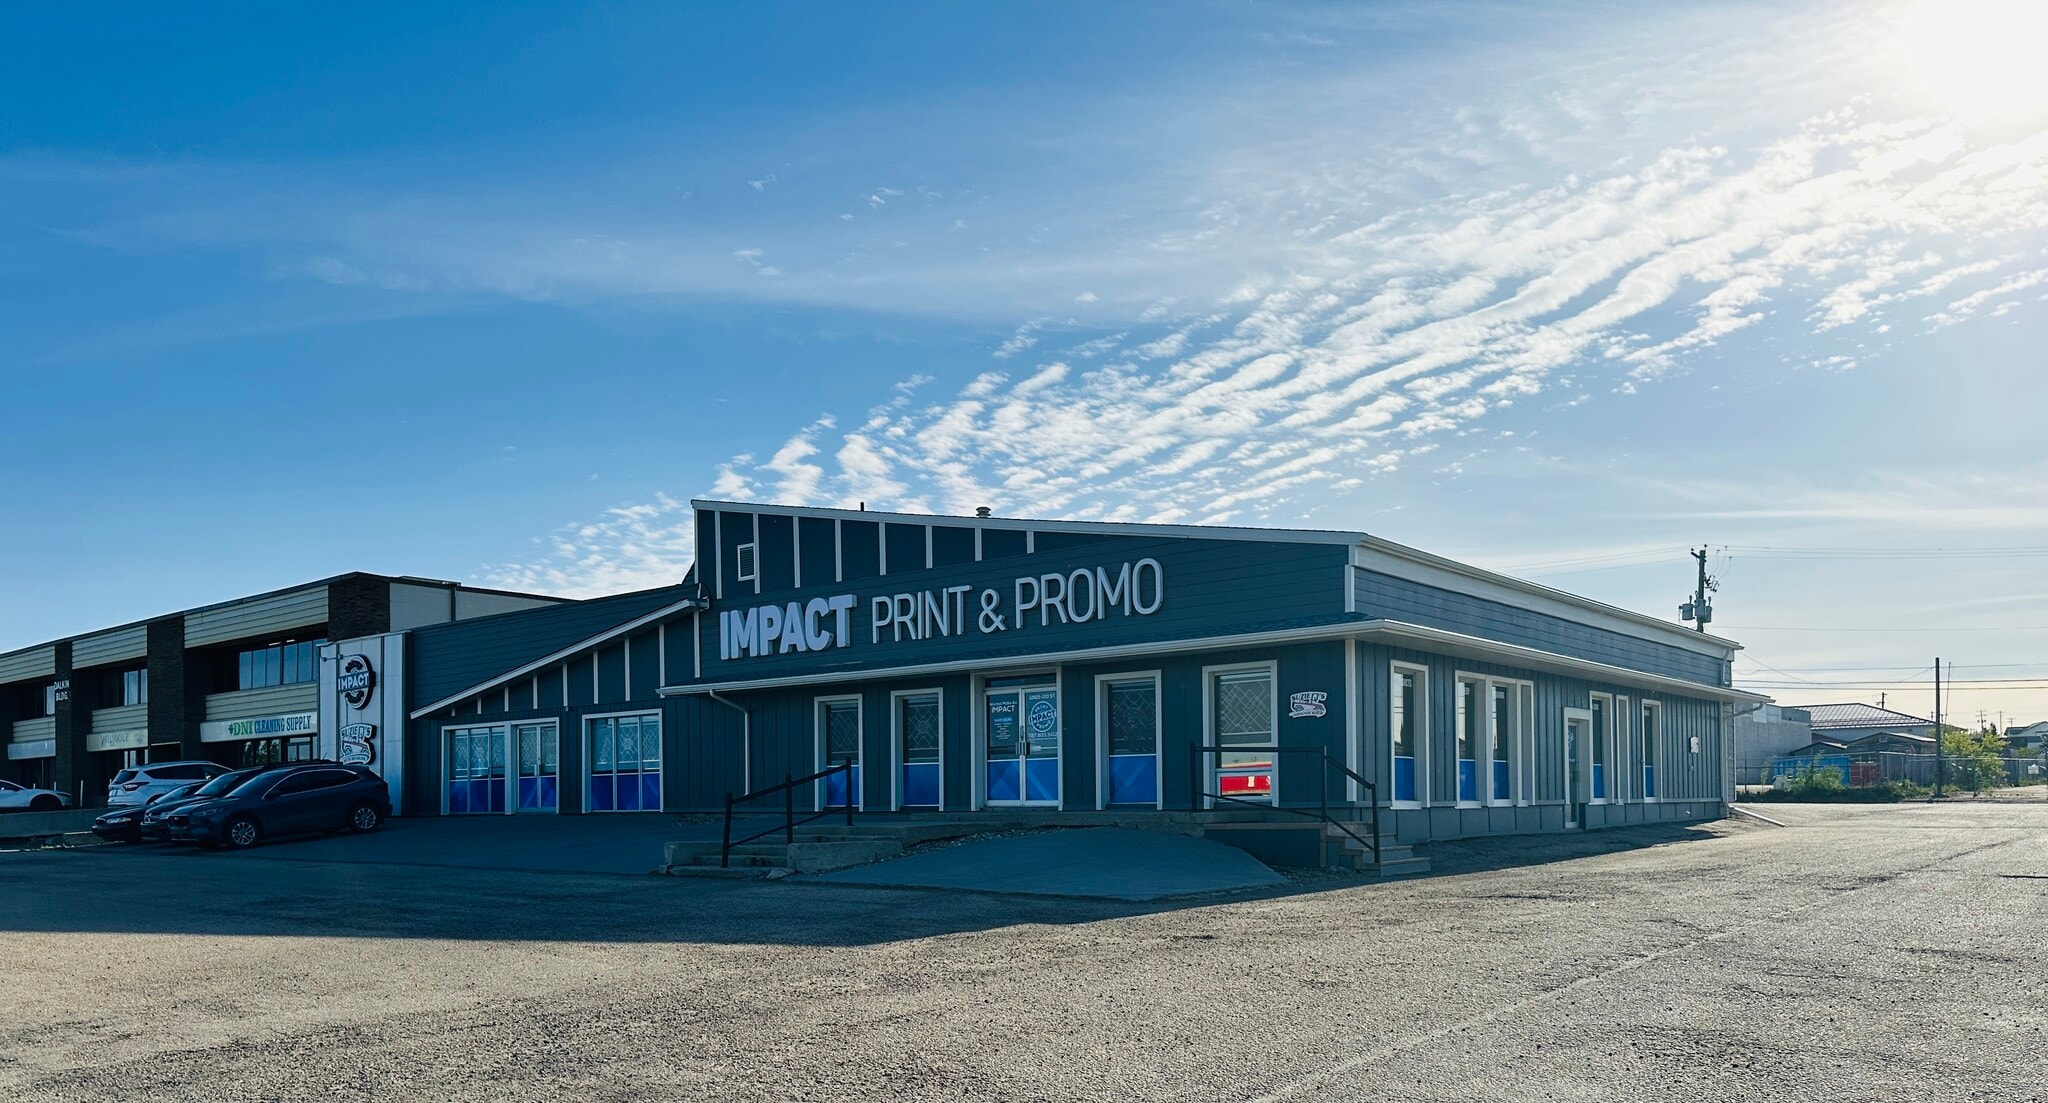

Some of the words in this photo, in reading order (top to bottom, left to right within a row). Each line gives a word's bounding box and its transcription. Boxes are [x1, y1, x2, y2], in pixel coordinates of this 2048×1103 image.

[720, 594, 857, 660] IMPACT
[871, 585, 972, 644] PRINT
[978, 588, 1007, 633] &
[1015, 558, 1164, 629] PROMO
[338, 672, 369, 690] IMPACT
[1292, 693, 1310, 701] SUZIE
[1034, 703, 1048, 712] PRINT
[1029, 710, 1056, 723] IMPACT
[233, 720, 253, 736] DNI
[254, 718, 284, 734] CLEANING
[286, 715, 312, 732] SUPPLY
[341, 726, 358, 738] SUZIE
